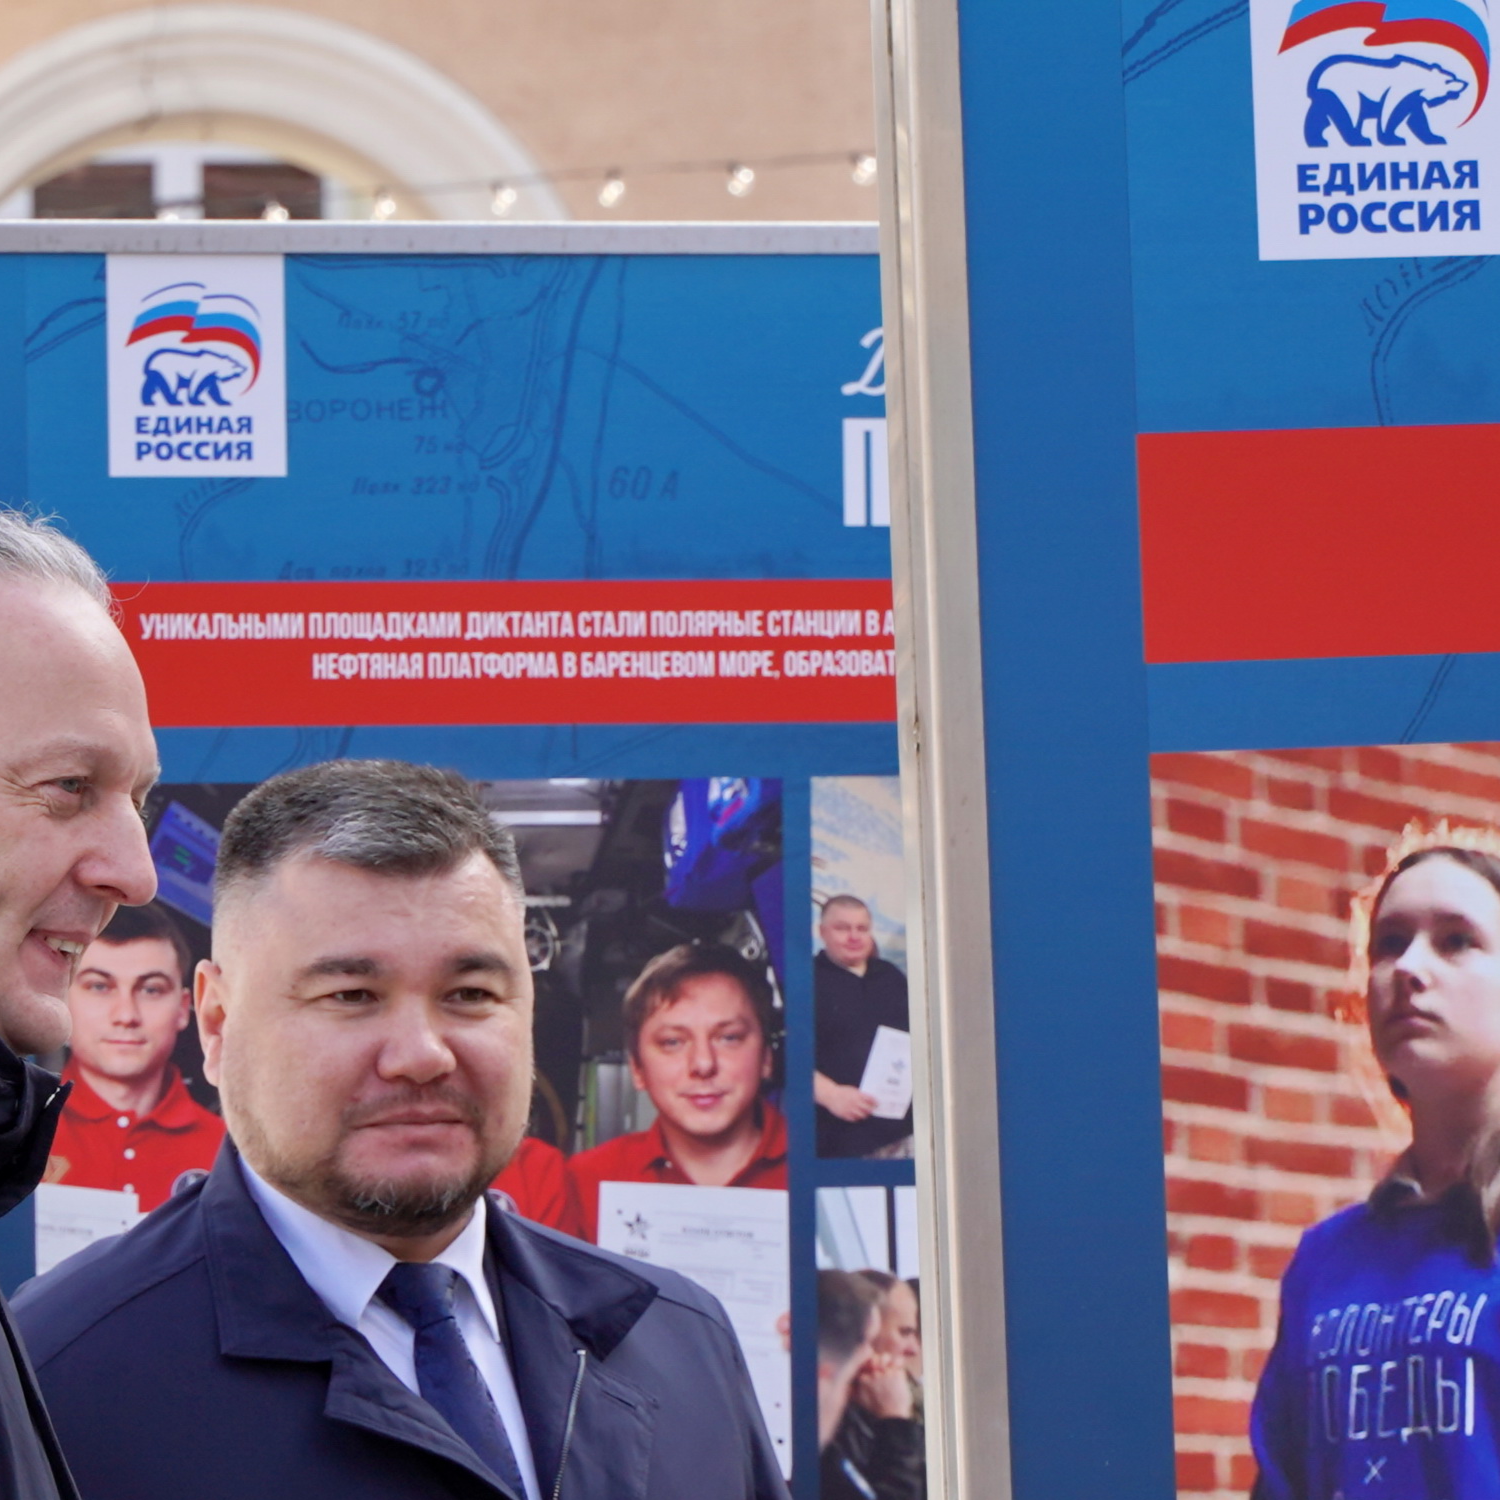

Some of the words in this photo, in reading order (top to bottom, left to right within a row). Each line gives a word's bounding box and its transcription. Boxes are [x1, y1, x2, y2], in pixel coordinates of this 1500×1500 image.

[1297, 160, 1480, 196] ЕДИНАЯ
[1298, 199, 1481, 235] РОССИЯ
[135, 416, 253, 437] ЕДИНАЯ
[135, 440, 253, 461] РОССИЯ
[139, 612, 304, 641] УНИКАЛЬНЫМИ
[308, 611, 461, 641] ПЛОЩАДКАМИ
[465, 611, 575, 640] ДИКТАНТА
[577, 610, 647, 639] СТАЛИ
[651, 610, 763, 638] ПОЛЯРНЫЕ
[766, 609, 862, 639] СТАНЦИИ
[865, 609, 880, 636] В
[311, 652, 424, 680] НЕФТЯНАЯ
[427, 651, 559, 680] ПЛАТФОРМА
[562, 651, 578, 679] В
[580, 650, 715, 681] БАРЕНЦЕВОМ
[718, 650, 781, 681] МОРЕ,
